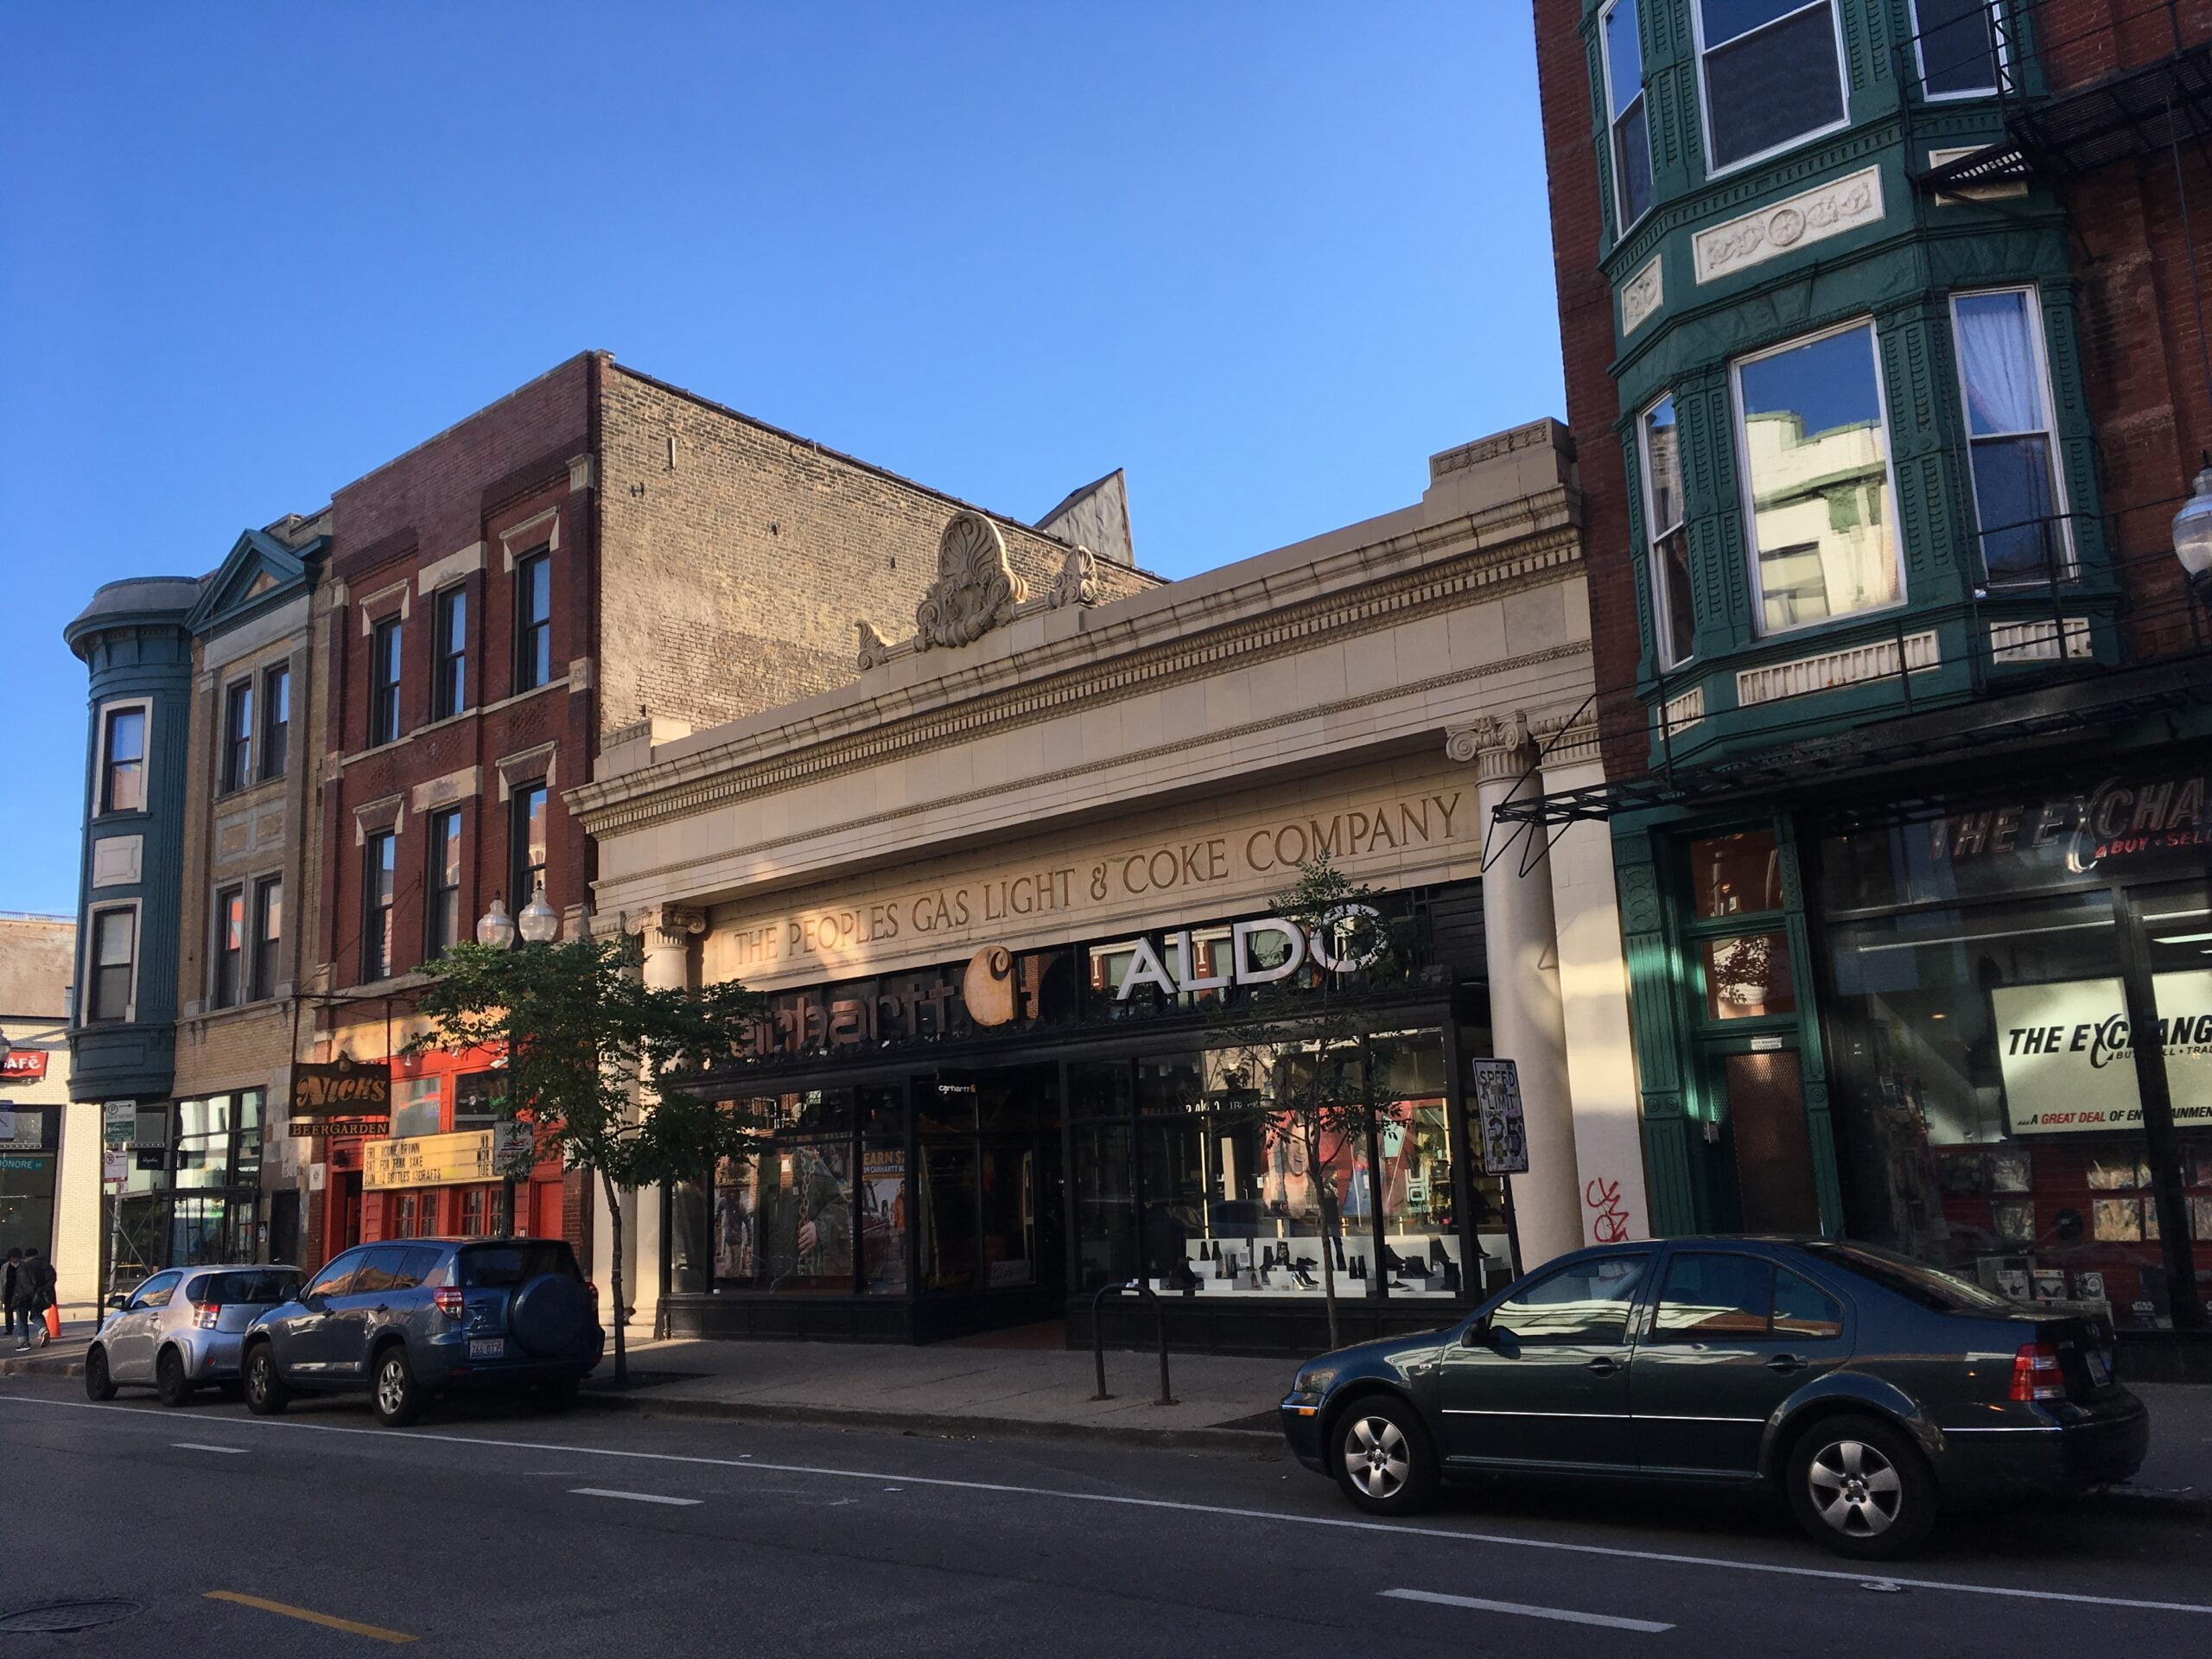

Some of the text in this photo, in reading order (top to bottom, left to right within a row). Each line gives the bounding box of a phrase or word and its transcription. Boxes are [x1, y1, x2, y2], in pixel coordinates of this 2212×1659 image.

[1929, 805, 2024, 859] THE
[2111, 837, 2149, 855] BUY
[734, 792, 1462, 965] THE PEOPLES GAS LIGHT & COKE COMPANY
[1116, 903, 1389, 1001] ALDO
[2008, 1025, 2065, 1056] THE
[1486, 1093, 1515, 1110] LIMIT
[2041, 1112, 2077, 1125] GREAT
[2078, 1111, 2106, 1123] DEAL
[2109, 1109, 2125, 1122] OF
[293, 1123, 387, 1135] BEERGARDEN
[366, 1146, 376, 1159] FRI
[863, 1150, 893, 1165] EARN
[365, 1160, 375, 1173] SAT
[380, 1158, 390, 1171] FOR
[410, 1155, 423, 1168] SAKE
[870, 1165, 898, 1173] CARHARTT
[387, 1170, 410, 1184] BOTTLES
